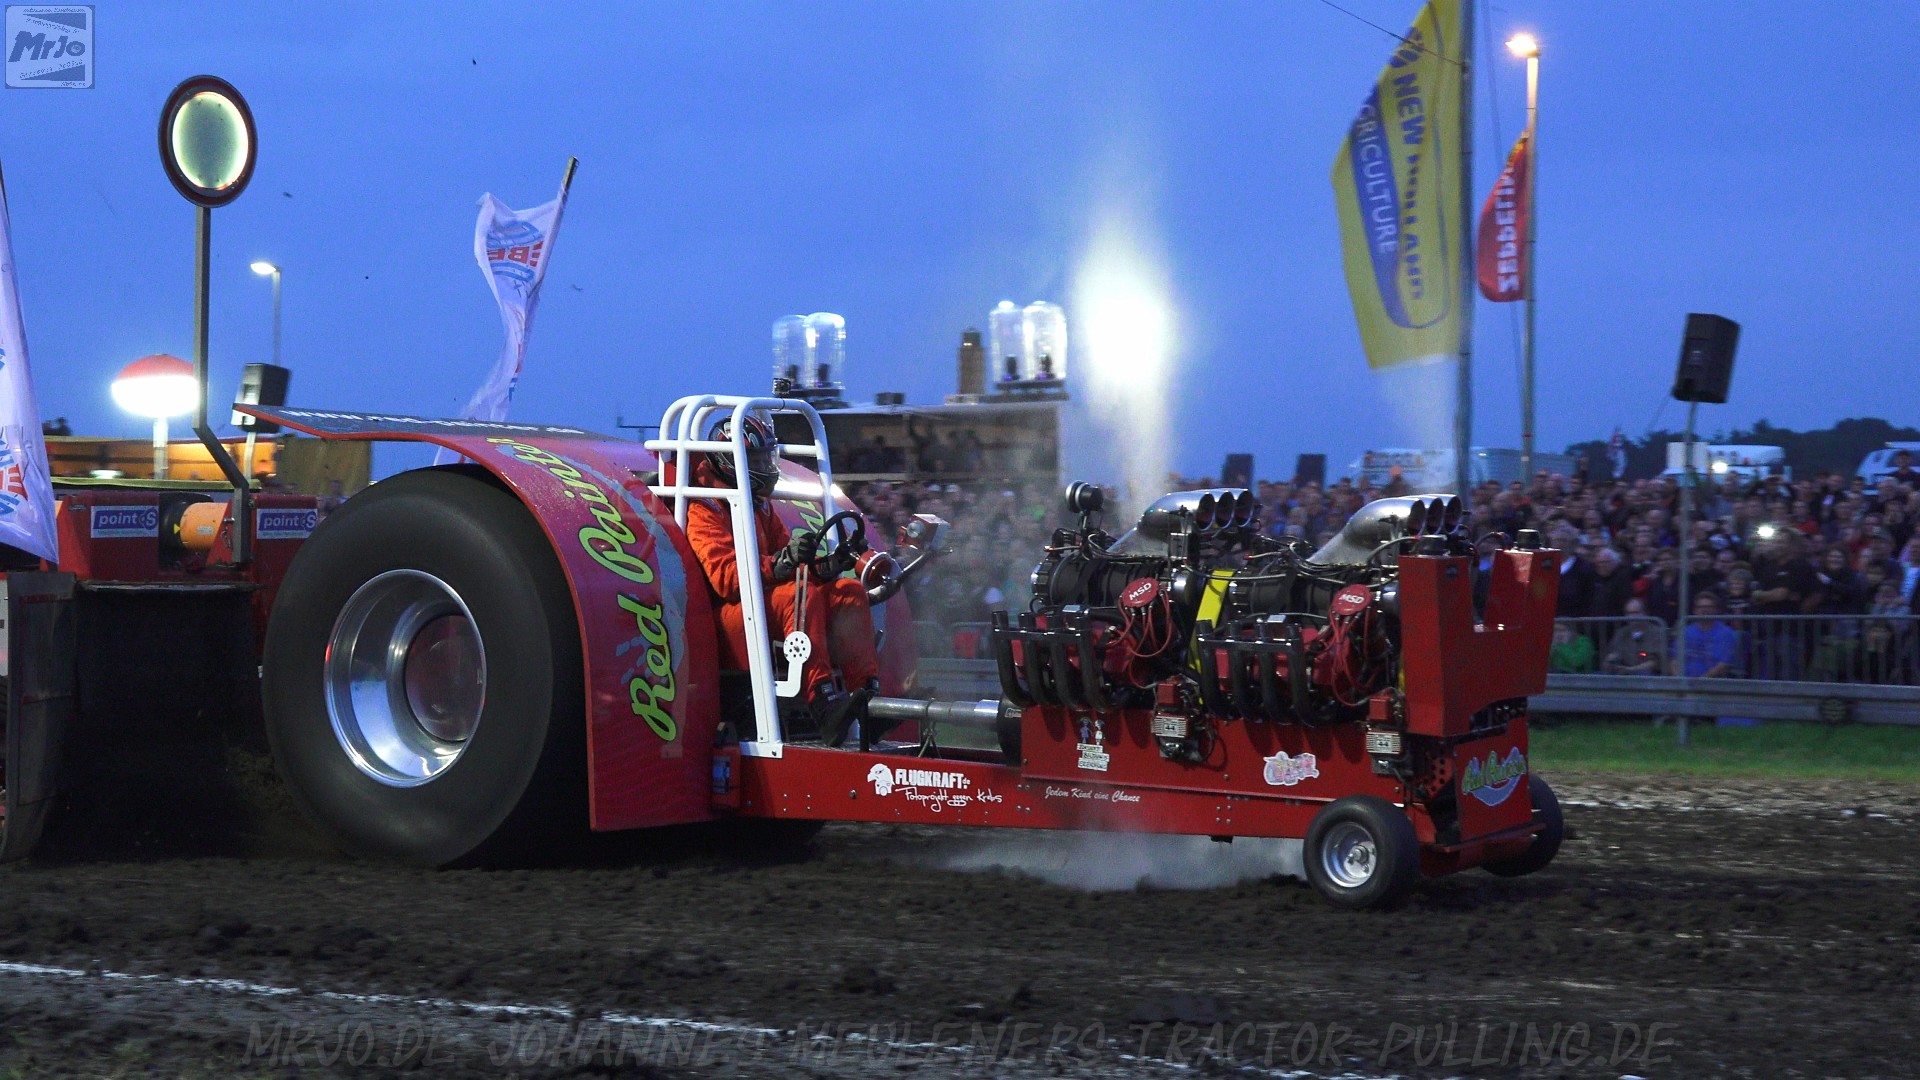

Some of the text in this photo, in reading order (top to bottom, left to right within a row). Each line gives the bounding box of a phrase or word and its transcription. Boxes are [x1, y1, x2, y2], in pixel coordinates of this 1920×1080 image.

[1390, 72, 1425, 146] NEW
[1356, 104, 1398, 253] GRICULTURE
[98, 511, 157, 527] point S
[264, 515, 299, 529] point
[1129, 582, 1153, 601] MSD
[1336, 592, 1365, 605] MSD
[618, 594, 677, 742] Red
[977, 788, 1003, 803] Krebs
[1045, 785, 1069, 799] Jedem
[1071, 787, 1092, 799] Kind
[1111, 790, 1140, 803] Chance
